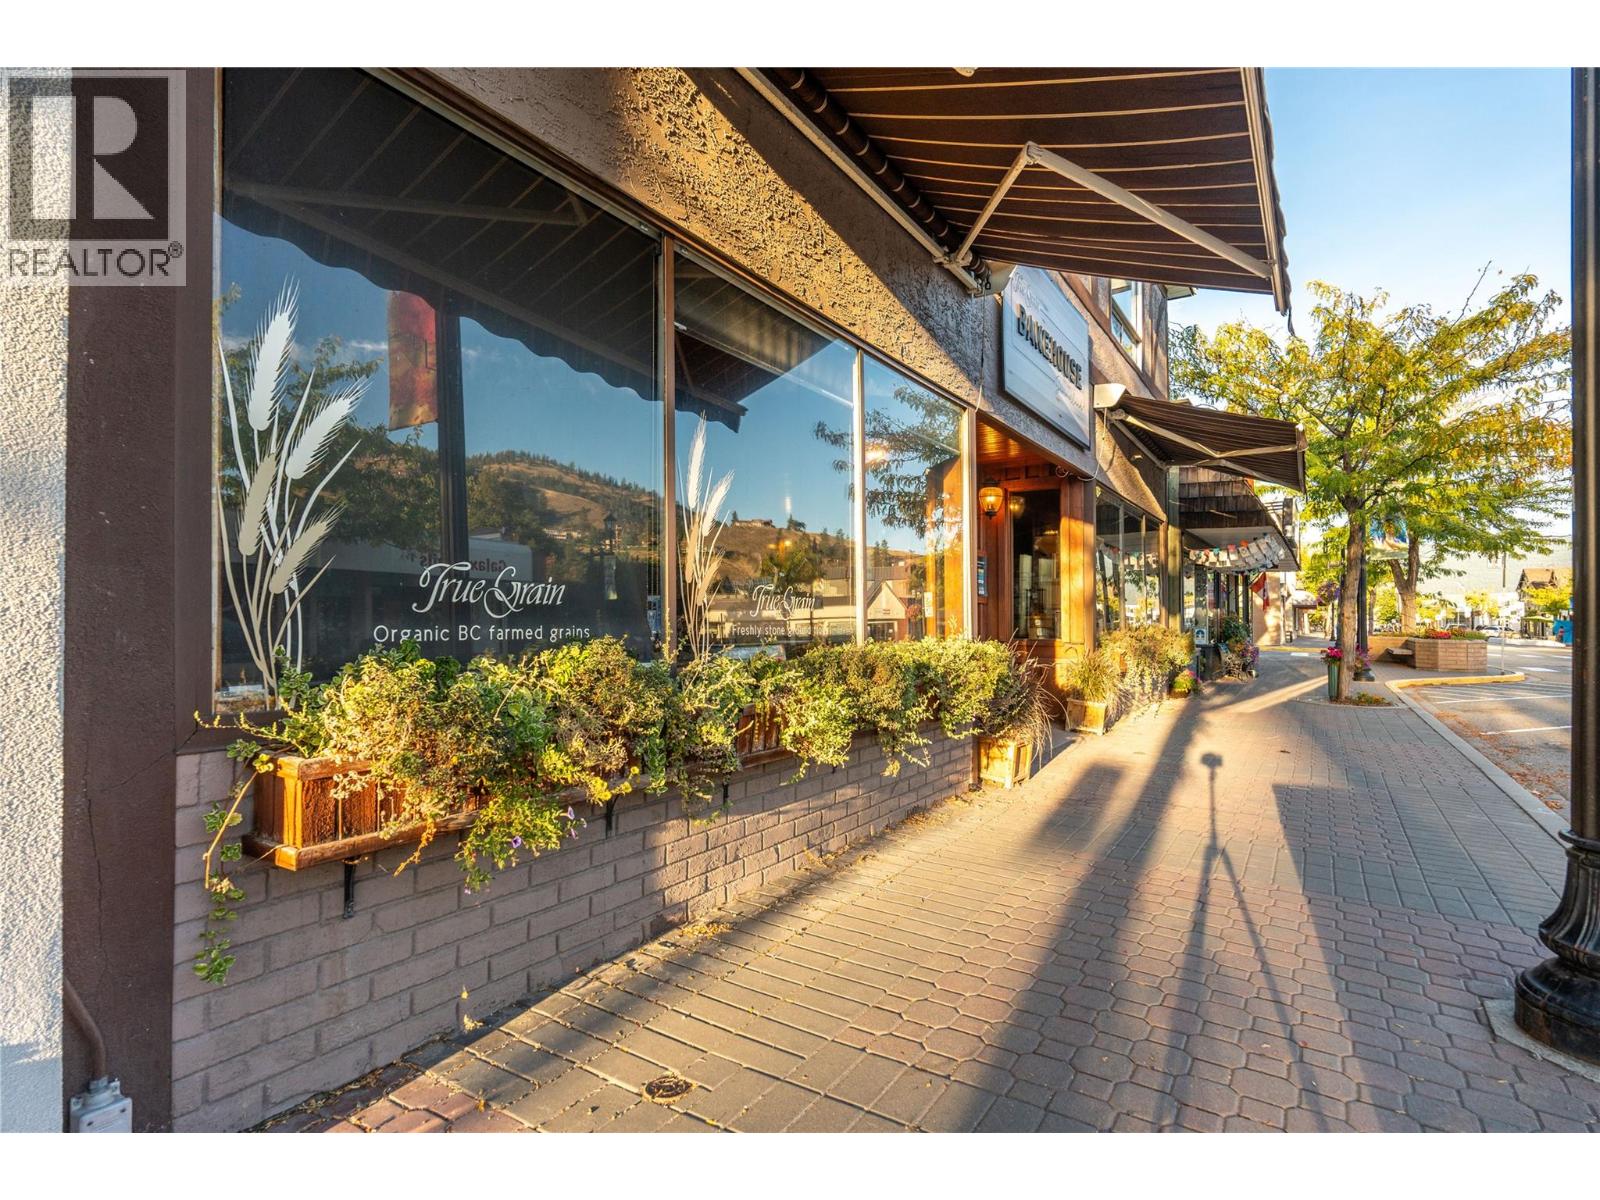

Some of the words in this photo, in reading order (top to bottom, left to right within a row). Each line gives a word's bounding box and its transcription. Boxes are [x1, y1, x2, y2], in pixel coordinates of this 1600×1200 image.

[1015, 303, 1083, 391] BAKEHOUSE
[411, 561, 487, 613] True
[483, 566, 566, 618] Grain
[749, 583, 780, 617] True
[780, 585, 816, 620] Grain
[373, 625, 450, 644] Organic
[458, 625, 481, 641] BC
[489, 625, 543, 641] farmed
[549, 625, 590, 643] grains
[732, 624, 761, 638] Freshly
[765, 624, 785, 636] stone
